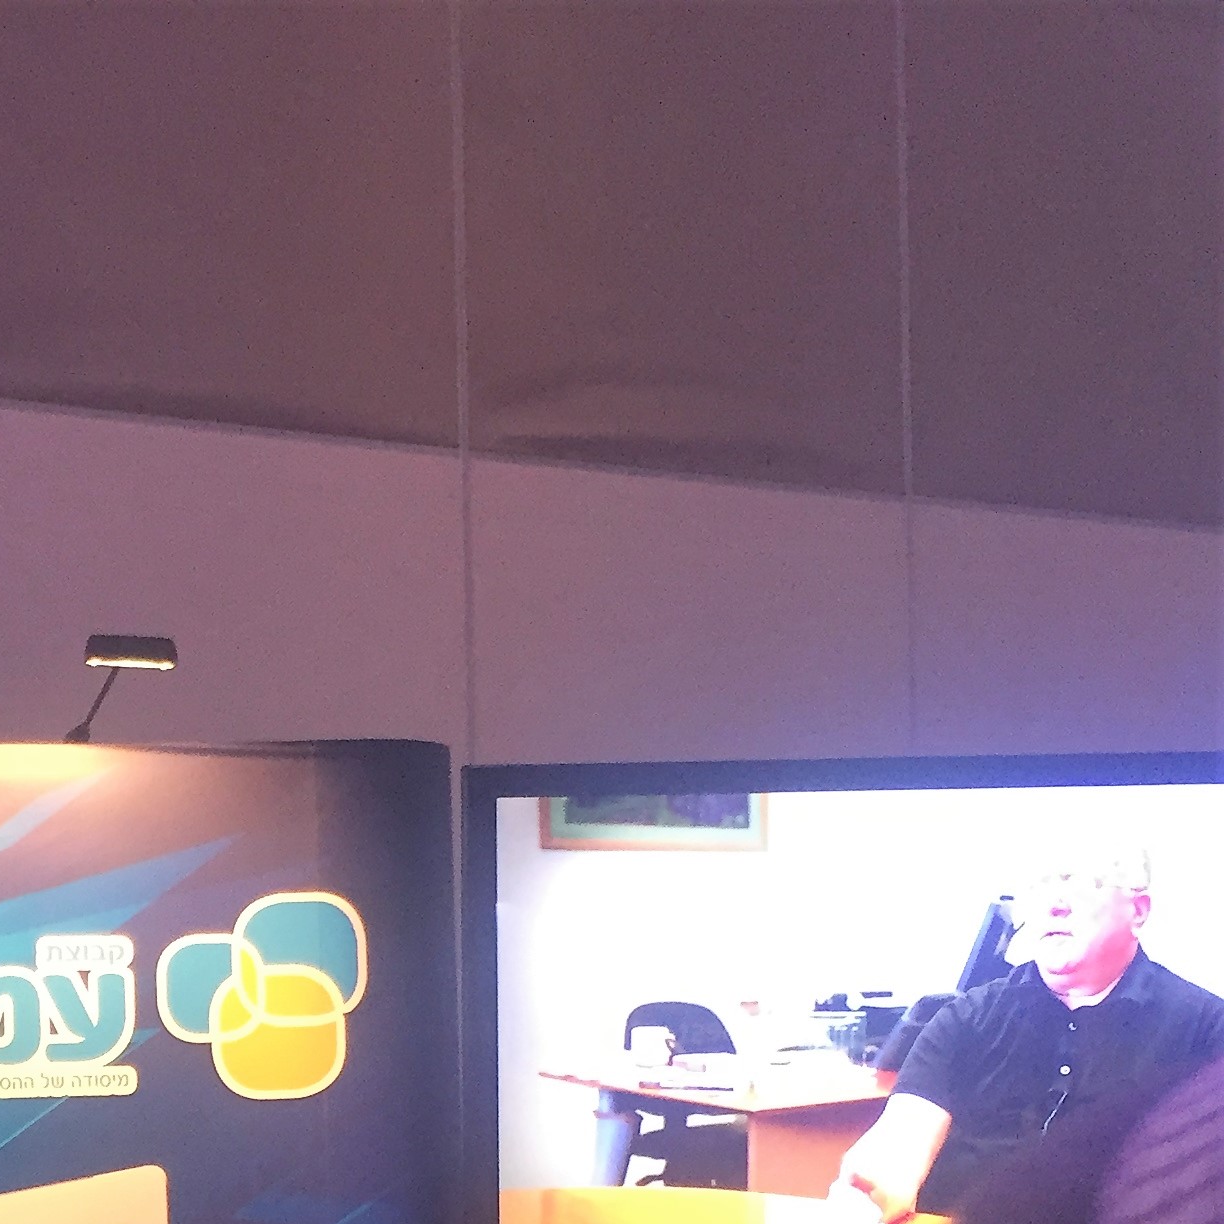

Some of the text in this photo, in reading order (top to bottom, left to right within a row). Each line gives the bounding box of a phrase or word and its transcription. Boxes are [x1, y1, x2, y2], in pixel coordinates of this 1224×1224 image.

[46, 944, 125, 966] קבוצת
[40, 1072, 65, 1089] של
[71, 1072, 130, 1089] מיסודה
